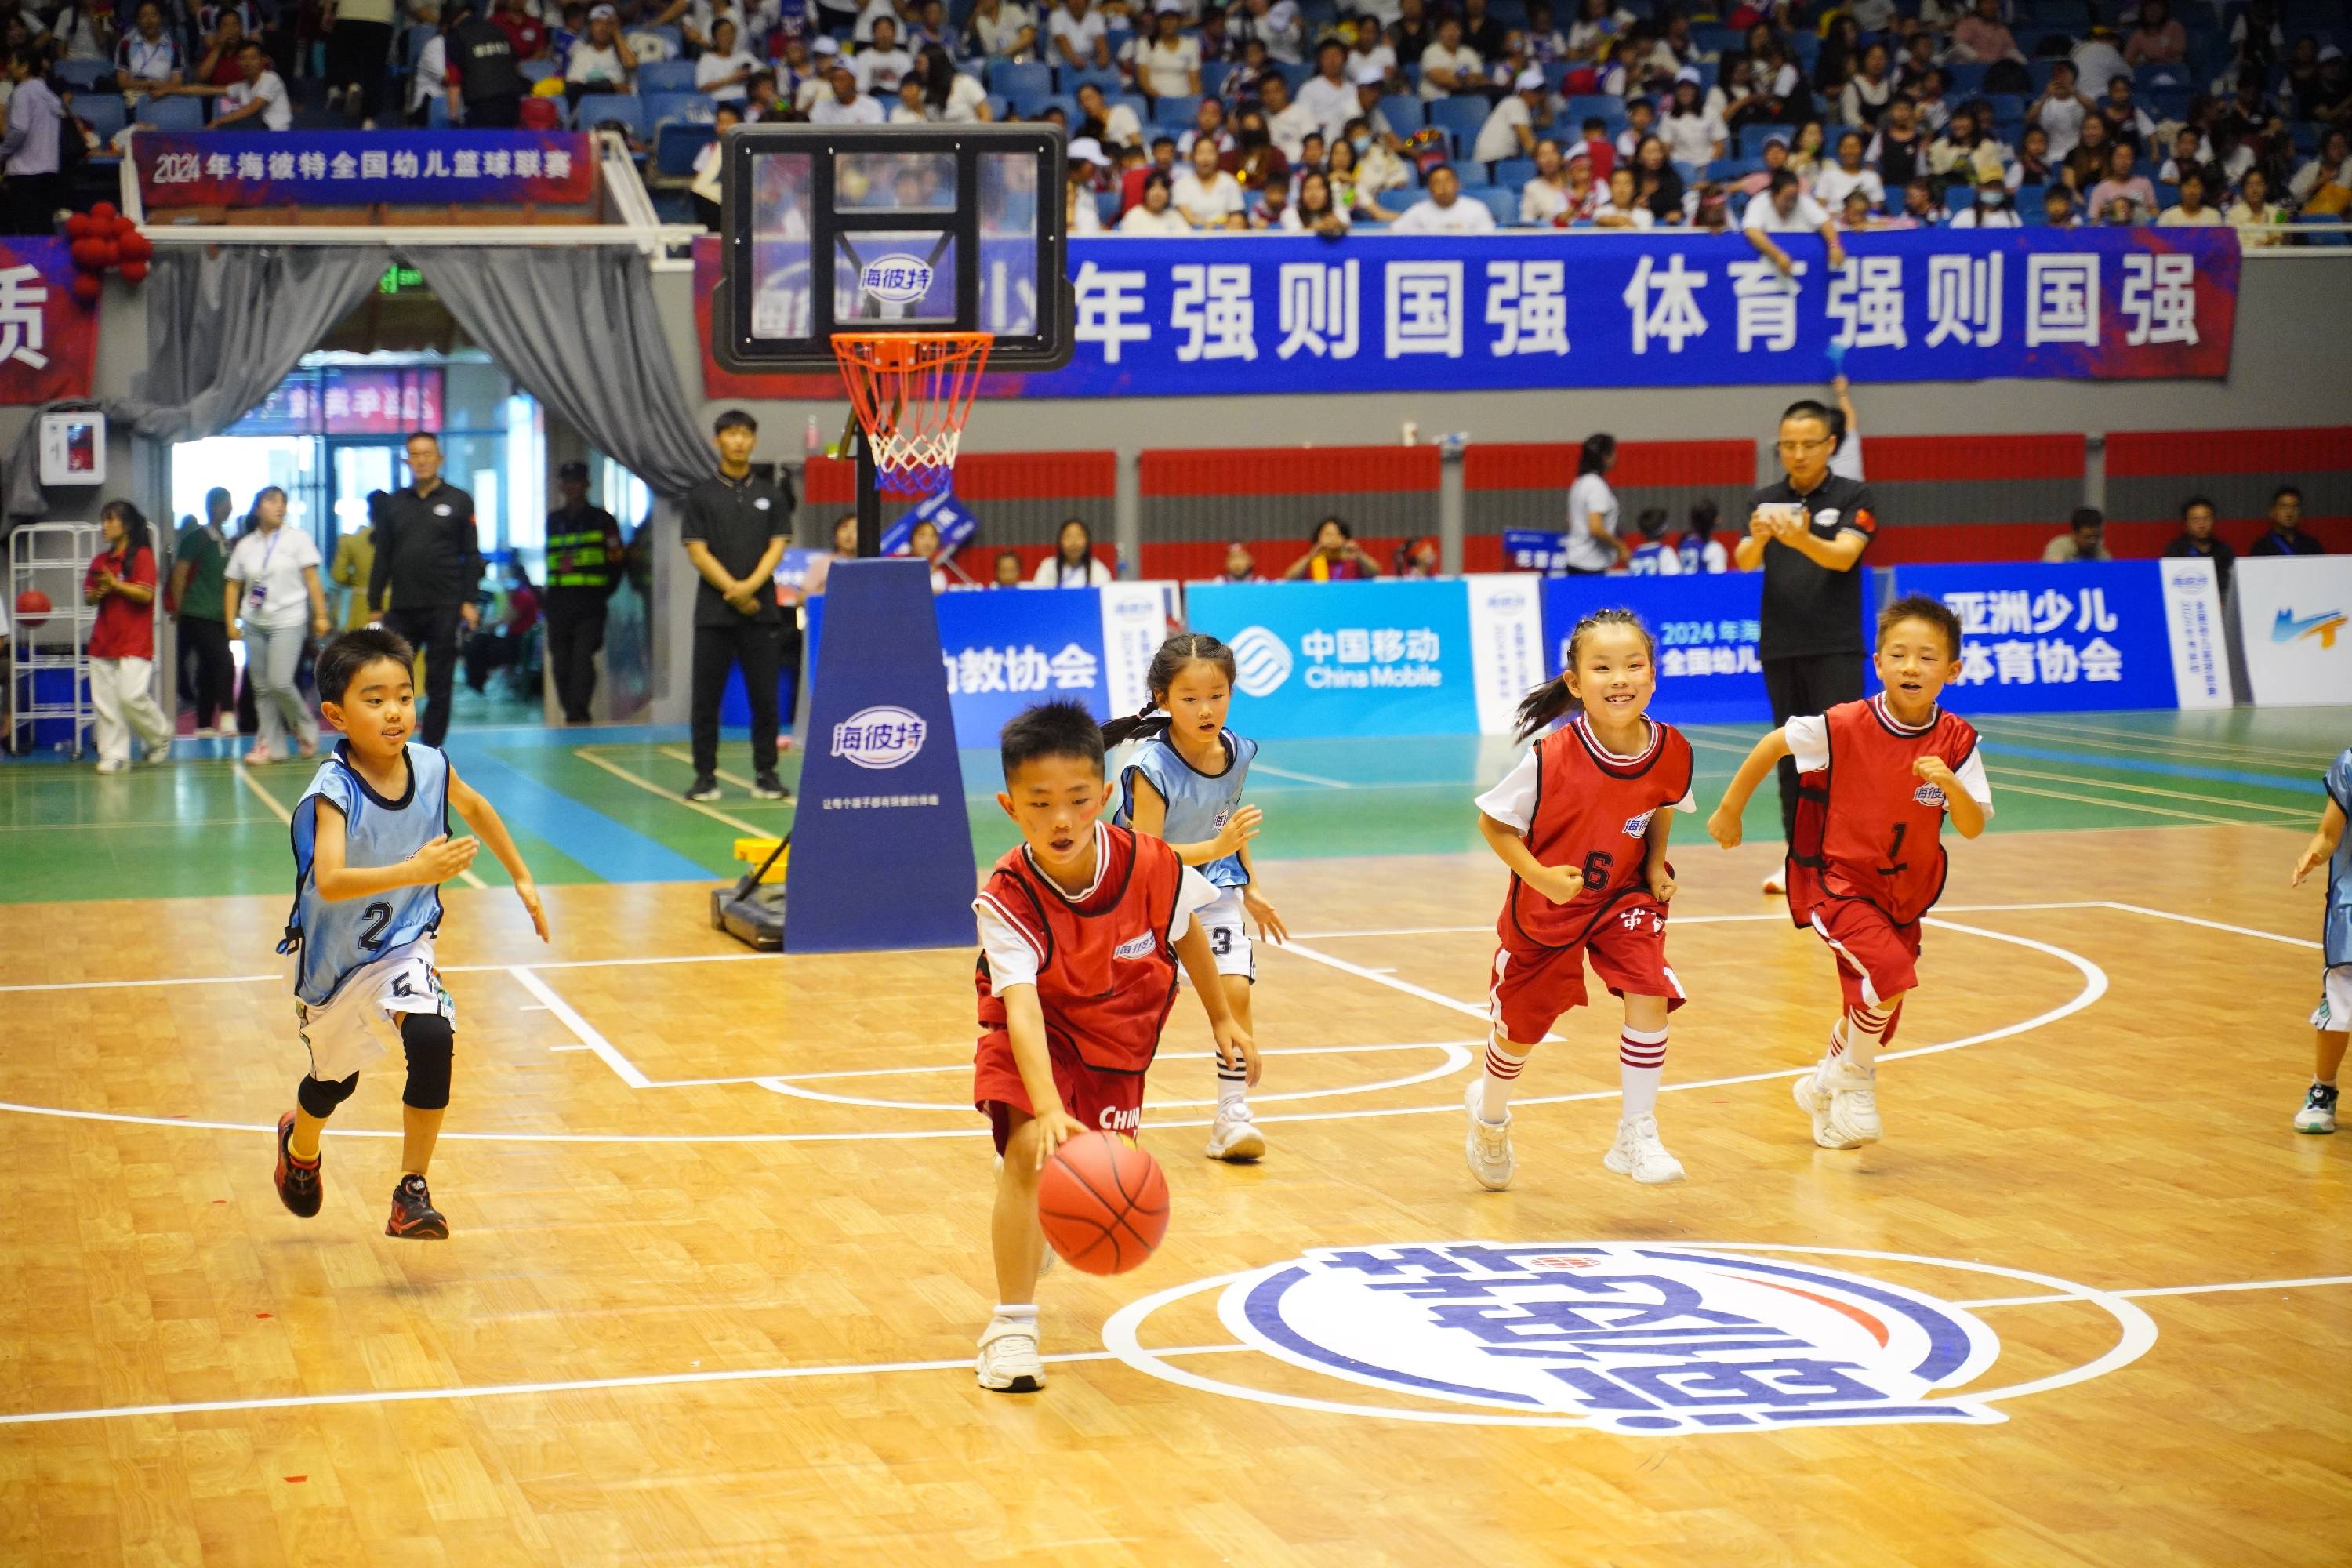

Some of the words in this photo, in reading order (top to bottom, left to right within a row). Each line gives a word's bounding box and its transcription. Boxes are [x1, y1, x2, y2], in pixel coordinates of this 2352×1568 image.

[862, 267, 931, 290] 海彼特
[1623, 251, 2201, 354] 体育强则国强
[1943, 588, 2118, 635] 亚洲少儿
[1301, 626, 1440, 665] 中国移动
[1956, 637, 2122, 687] 体育协会
[1305, 665, 1369, 689] China
[1371, 664, 1442, 688] Mobile
[835, 721, 924, 753] 海彼特
[1915, 786, 1944, 800] 海彼
[1877, 822, 1907, 875] 1
[1582, 850, 1613, 891] 6
[358, 902, 394, 951] 2
[1212, 926, 1232, 956] 3
[391, 970, 412, 997] 5
[1320, 1244, 1976, 1431] 海彼特
